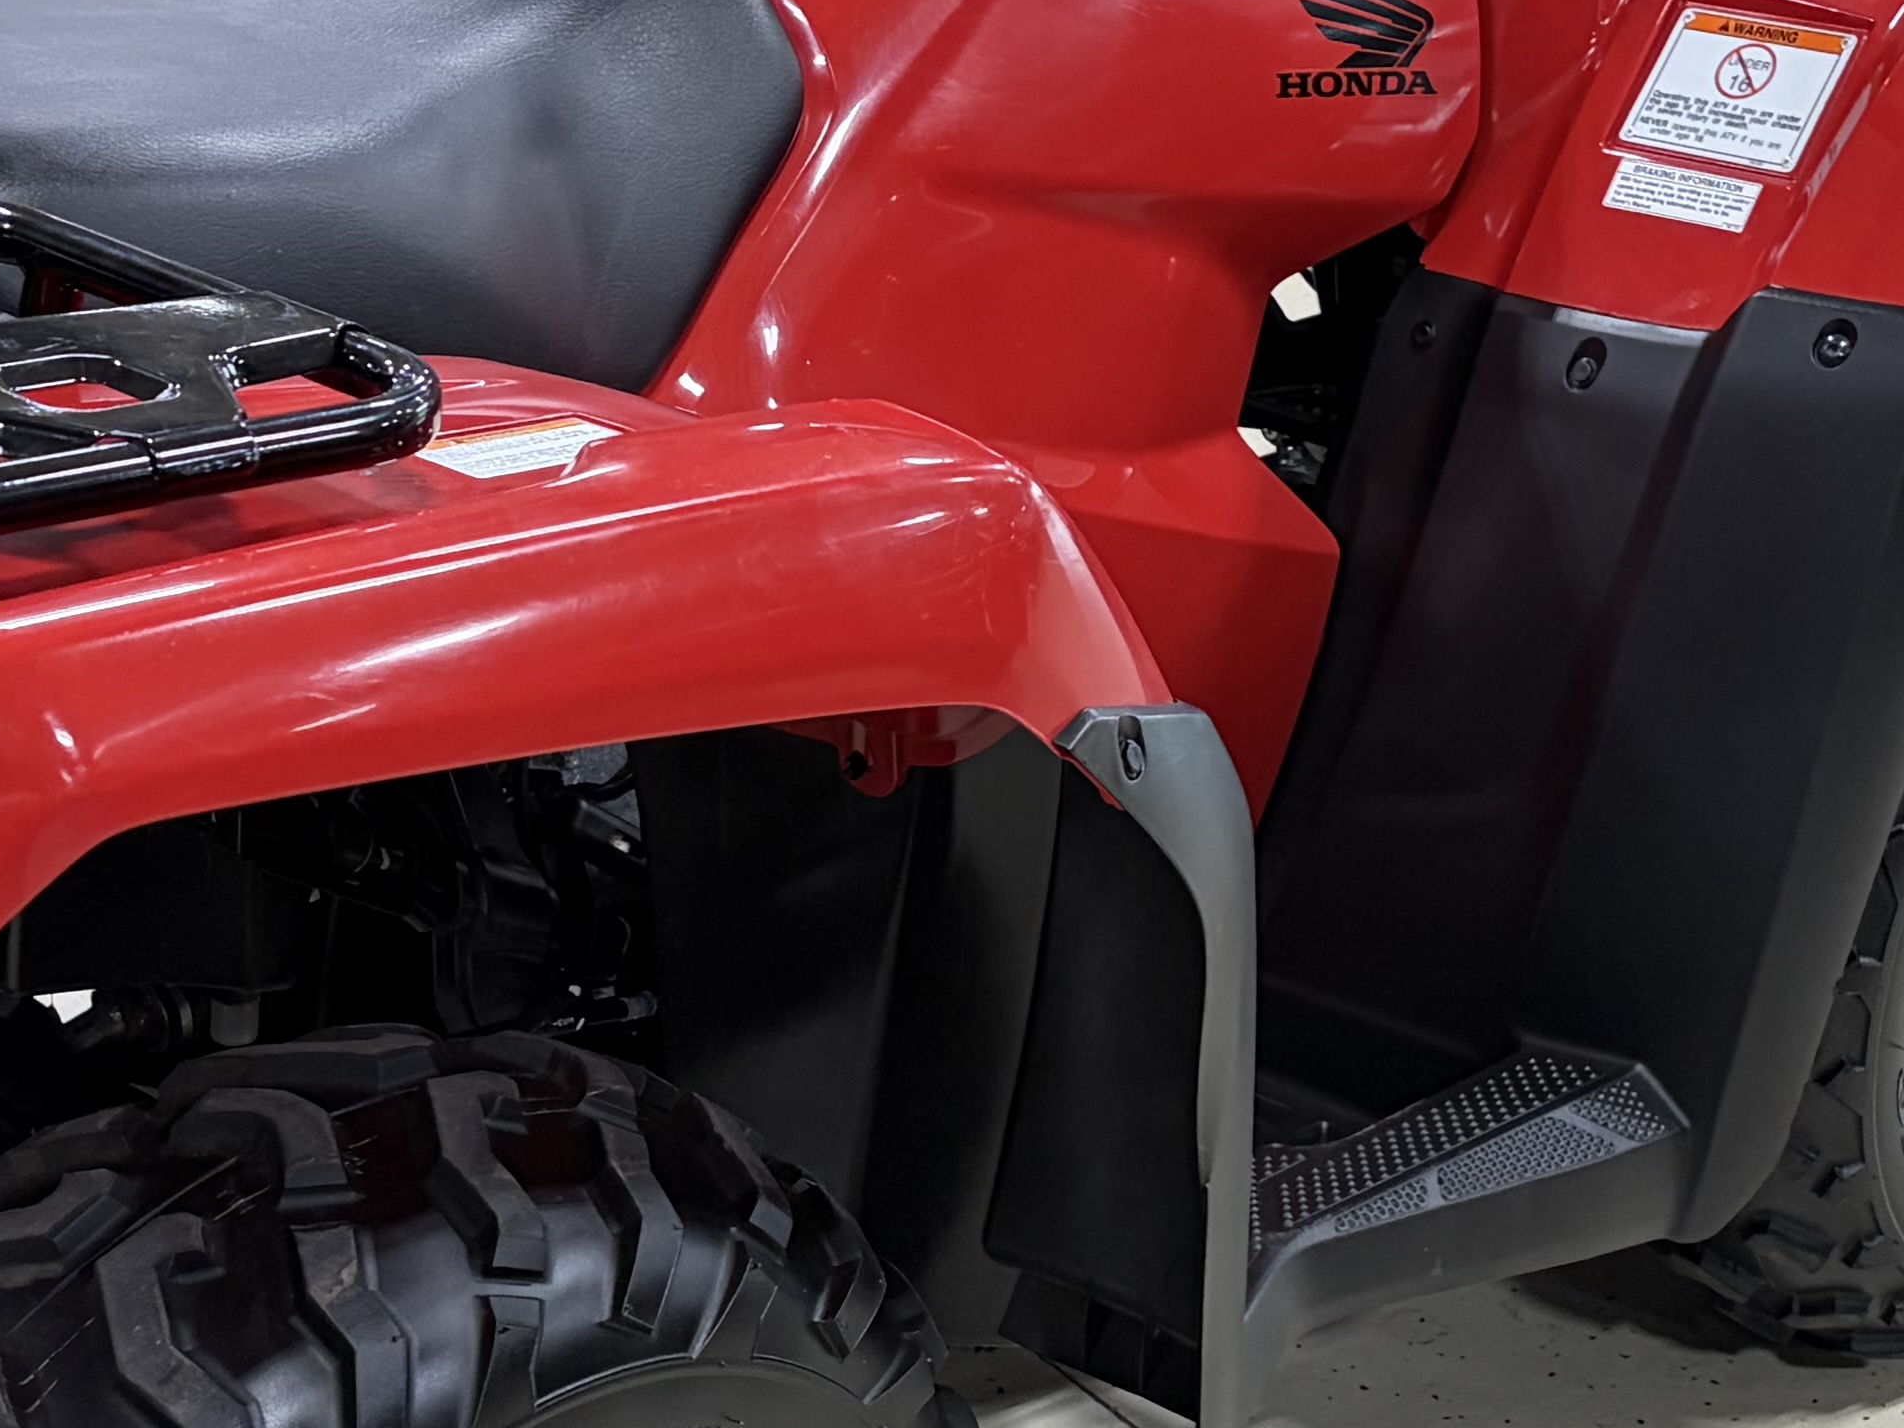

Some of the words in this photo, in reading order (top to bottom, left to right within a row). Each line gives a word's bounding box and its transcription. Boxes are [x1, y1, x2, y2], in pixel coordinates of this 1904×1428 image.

[1734, 24, 1799, 43] WARNING
[1728, 55, 1770, 71] UNDER
[1276, 70, 1437, 98] HONDA
[1728, 75, 1751, 93] 16
[1633, 165, 1676, 181] BRAKING
[1679, 174, 1744, 193] INFORMATION
